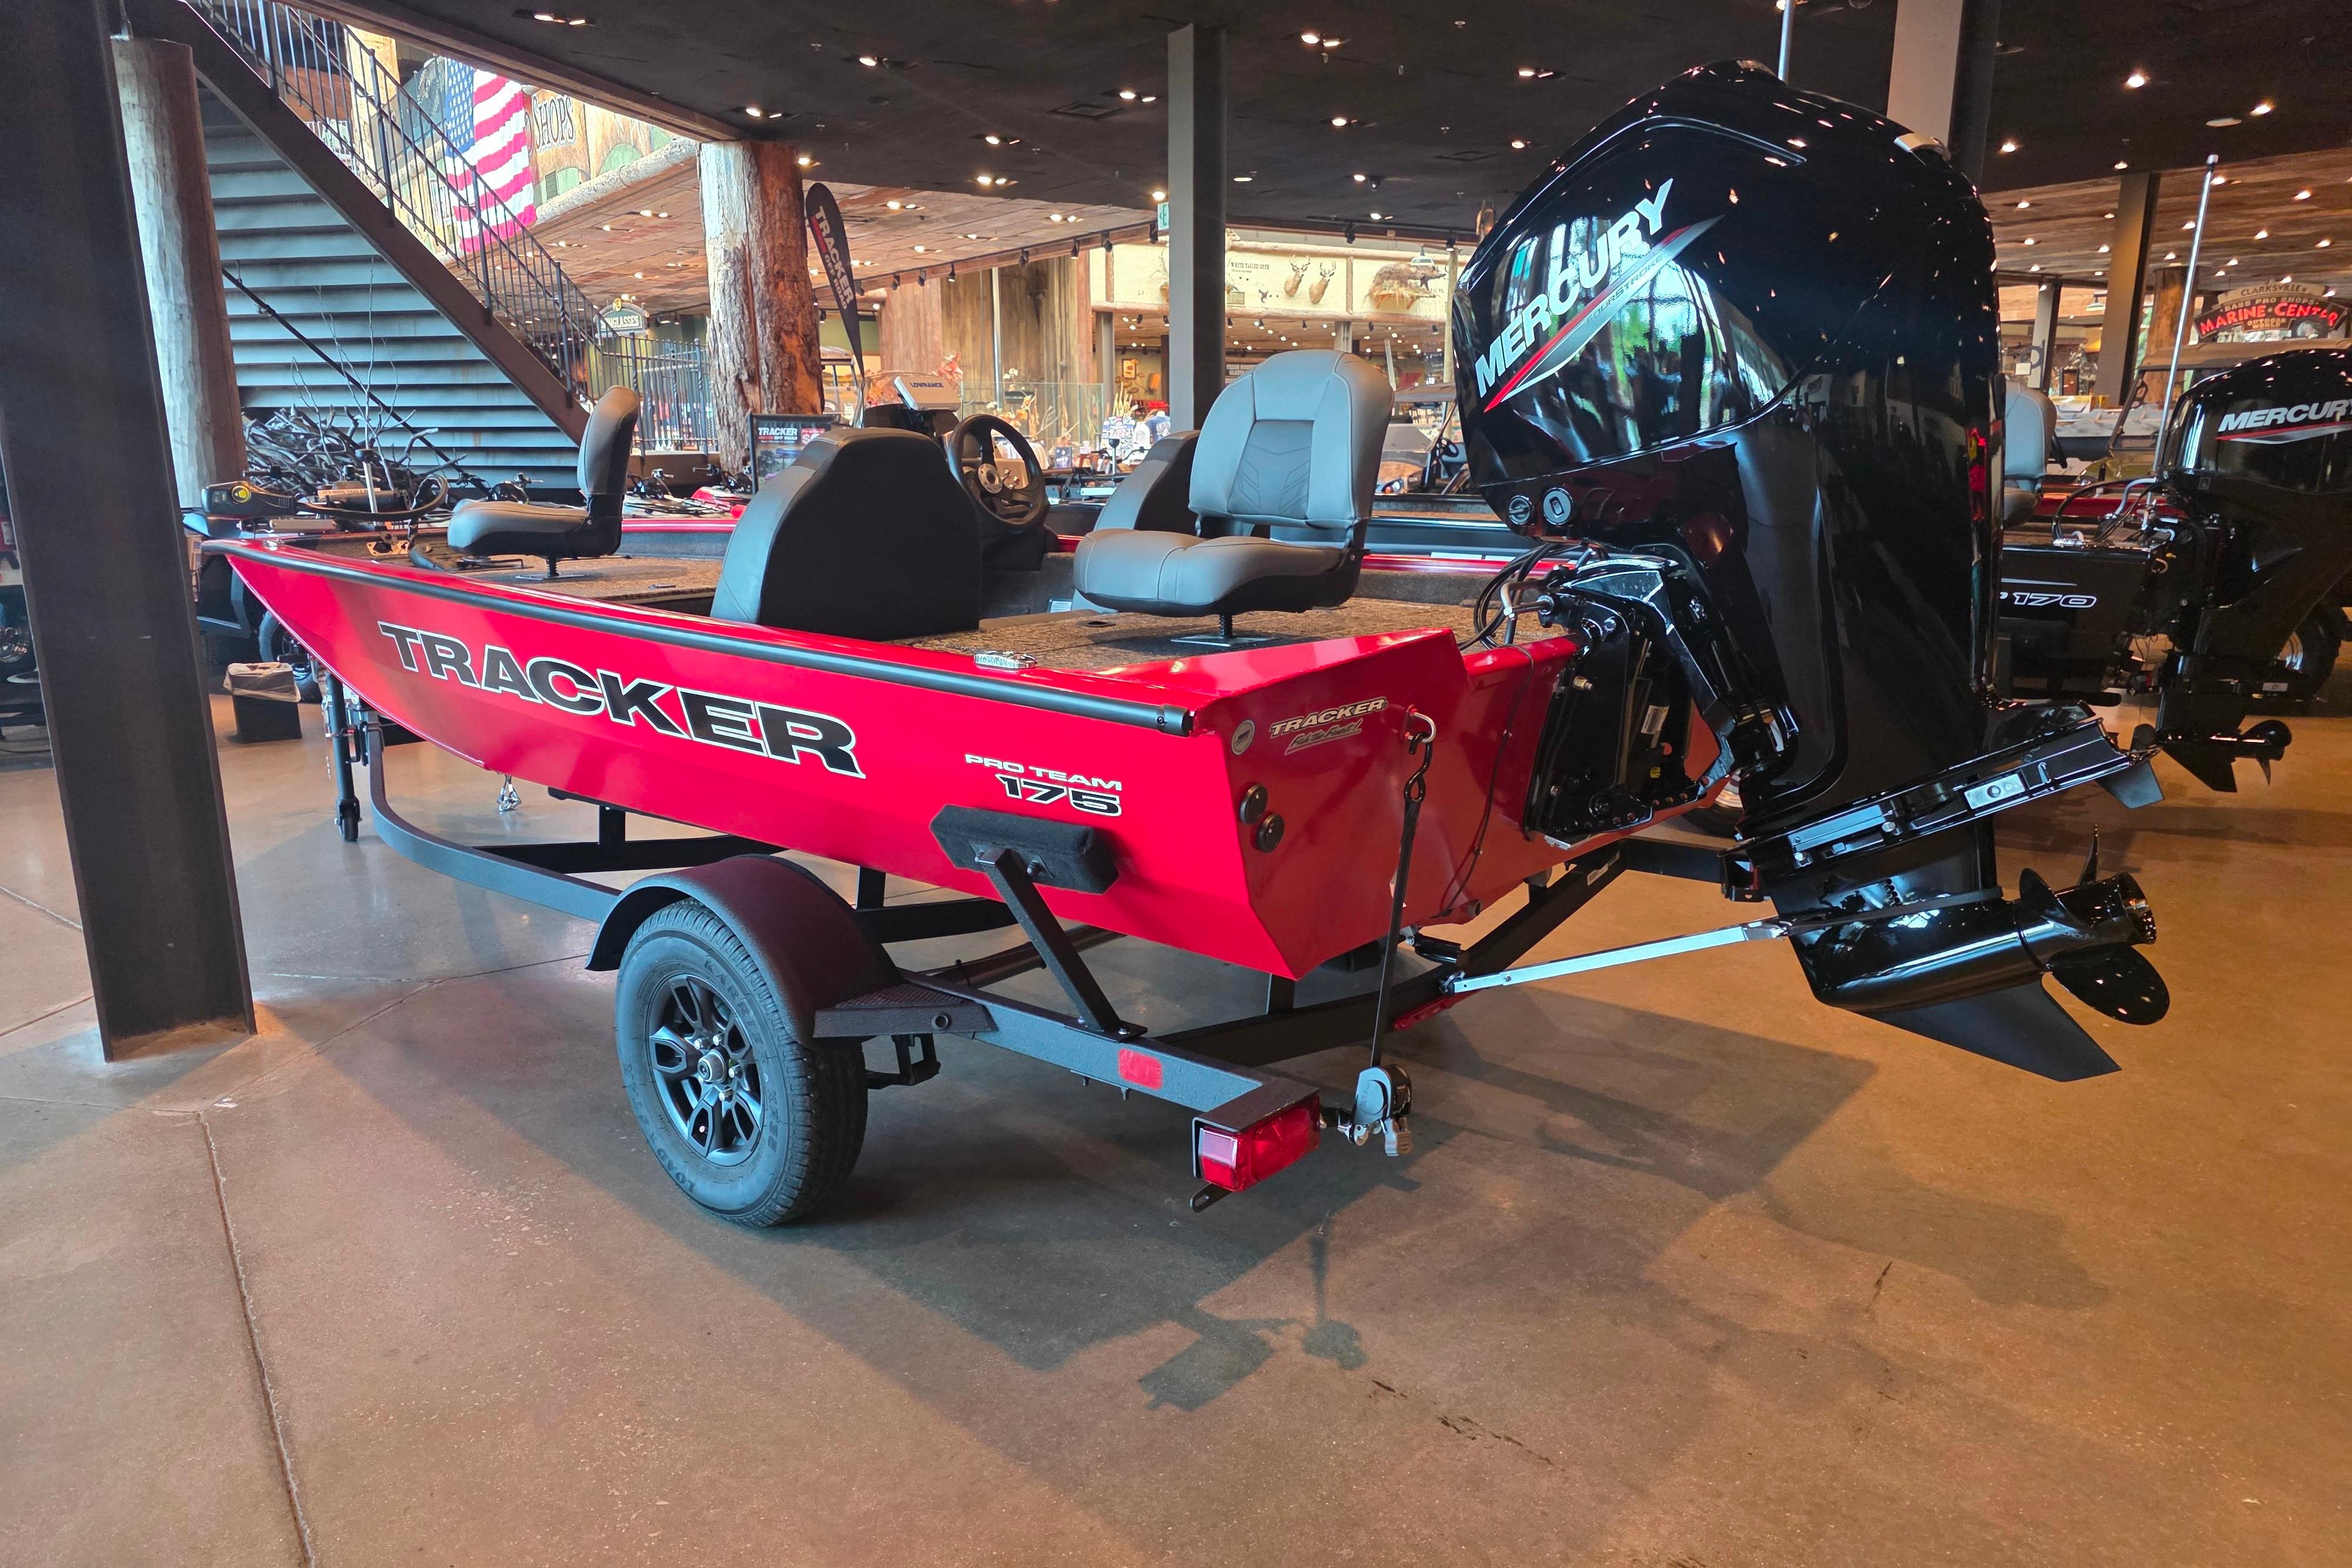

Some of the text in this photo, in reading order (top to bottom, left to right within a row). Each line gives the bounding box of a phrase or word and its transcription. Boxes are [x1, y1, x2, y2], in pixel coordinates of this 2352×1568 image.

[533, 96, 574, 149] SHOPS
[814, 206, 854, 305] TRACKER
[1475, 178, 1673, 398] MERCURY
[2225, 296, 2315, 312] BASS PRO SHOPS
[2241, 284, 2302, 296] CLARKSVILLE
[2200, 305, 2266, 335] MARINE
[758, 427, 798, 436] TRACKER
[2218, 398, 2352, 432] MERCUR
[2012, 592, 2097, 608] 170
[377, 621, 866, 780] TRACKER
[1270, 698, 1387, 737] TRACKER
[965, 754, 1123, 791] PRO TEAM
[994, 773, 1122, 817] 175
